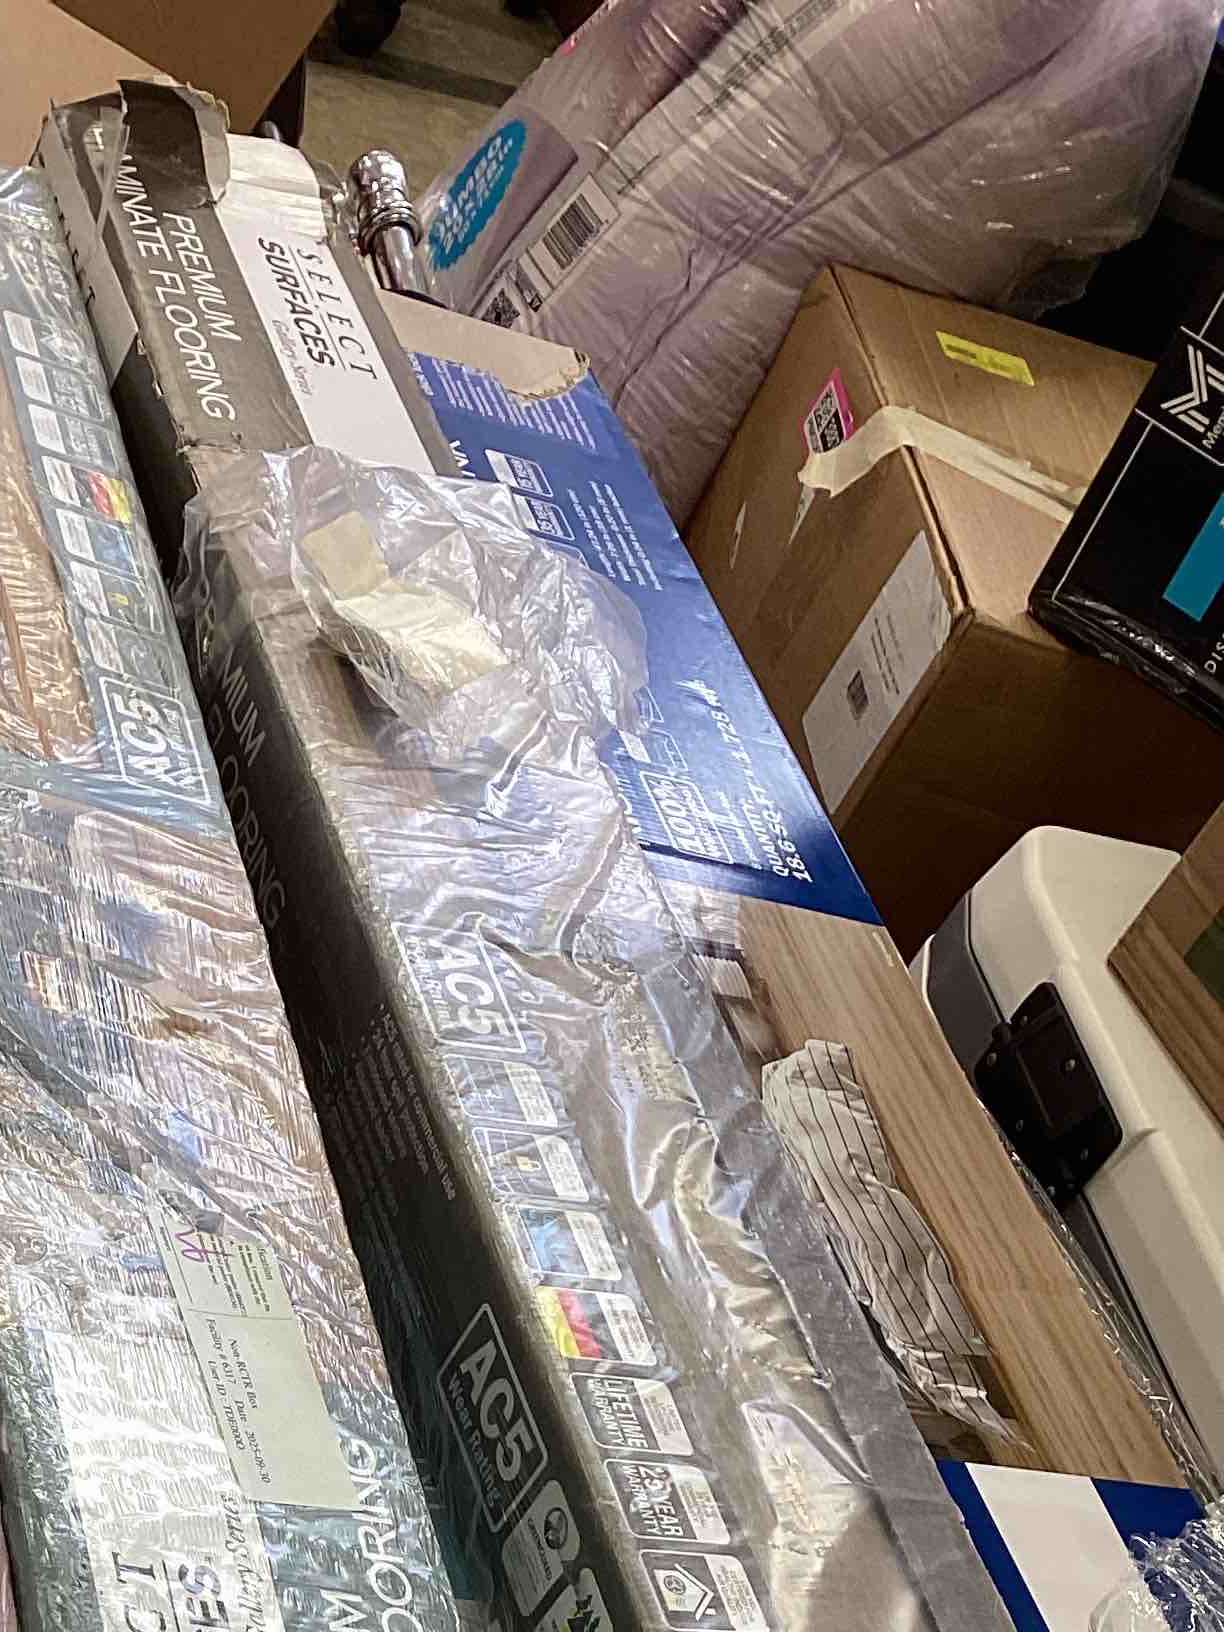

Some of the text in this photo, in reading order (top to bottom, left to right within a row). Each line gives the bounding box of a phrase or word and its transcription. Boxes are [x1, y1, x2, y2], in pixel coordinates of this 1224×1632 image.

[114, 152, 236, 422] MINATE FLOORING
[162, 210, 242, 342] PREMIUM
[258, 236, 336, 370] SURFACES
[296, 247, 378, 381] SELECT
[112, 691, 173, 779] AC5
[216, 643, 266, 768] MIUM
[778, 838, 814, 883] 18.6
[435, 939, 512, 1038] AC5
[458, 1338, 534, 1482] AC5
[585, 1377, 624, 1447] WARRANTY
[604, 1377, 649, 1449] LIFETIME
[622, 1464, 664, 1537] WARRANTY
[651, 1493, 685, 1538] YEAR
